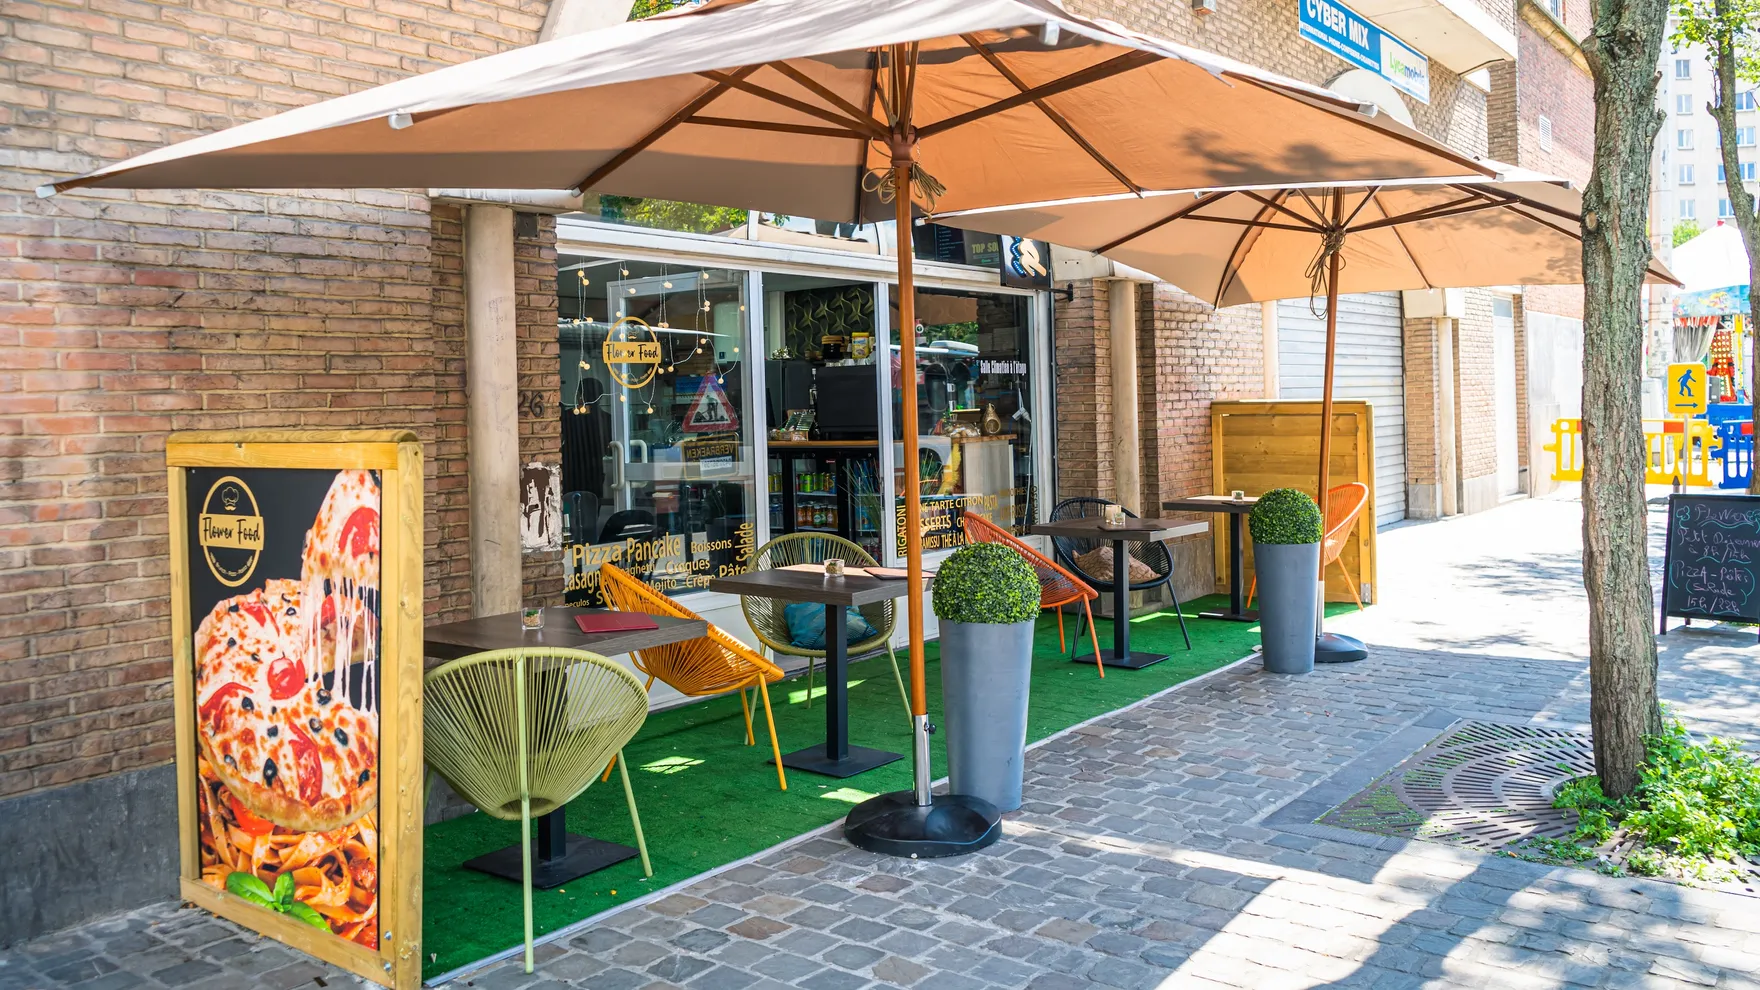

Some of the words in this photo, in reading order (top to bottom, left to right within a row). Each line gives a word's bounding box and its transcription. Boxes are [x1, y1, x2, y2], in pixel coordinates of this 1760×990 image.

[1307, 0, 1347, 37] CYBER
[1348, 17, 1370, 50] MIX
[971, 243, 986, 254] TOP
[637, 343, 659, 361] Food
[930, 499, 955, 512] TARTE
[955, 496, 984, 508] CITRON
[202, 516, 234, 543] Flower
[236, 518, 260, 545] Food
[895, 504, 908, 557] RIGATONI
[920, 514, 952, 531] SSERTS
[572, 543, 622, 567] Pizza
[626, 532, 681, 563] Pancake
[690, 539, 732, 554] Boissons
[734, 522, 754, 562] Salade
[665, 559, 711, 575] Croques
